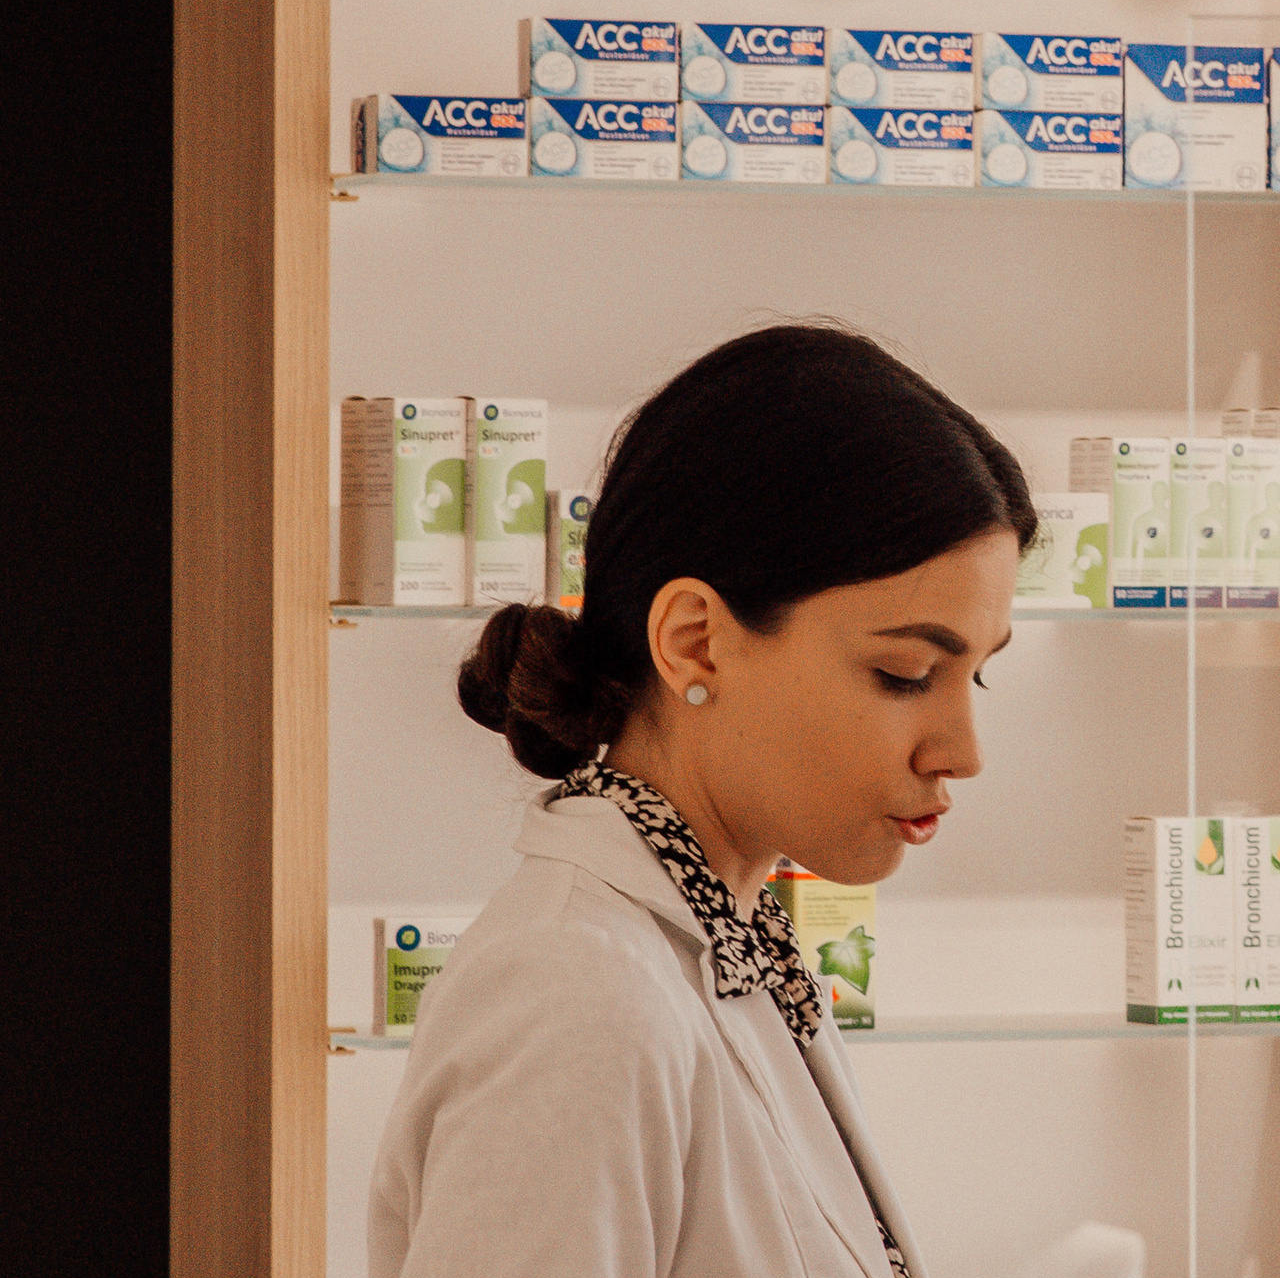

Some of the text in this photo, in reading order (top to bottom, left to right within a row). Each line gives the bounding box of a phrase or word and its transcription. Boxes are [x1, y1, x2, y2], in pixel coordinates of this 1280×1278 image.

[575, 23, 674, 51] ACC akut
[724, 27, 824, 54] ACC akut
[875, 34, 973, 61] ACC akut
[1026, 38, 1121, 65] ACC akut
[1161, 60, 1260, 88] ACC akut
[422, 99, 524, 127] ACC akut
[575, 103, 675, 131] ACC akut
[725, 107, 824, 135] ACC akut
[876, 112, 973, 140] ACC akut
[1026, 116, 1120, 143] ACC akut
[401, 428, 455, 443] Sinupret
[482, 428, 535, 443] Sinupret
[1165, 826, 1183, 949] Bronchicum
[1242, 826, 1261, 949] Bronchicum
